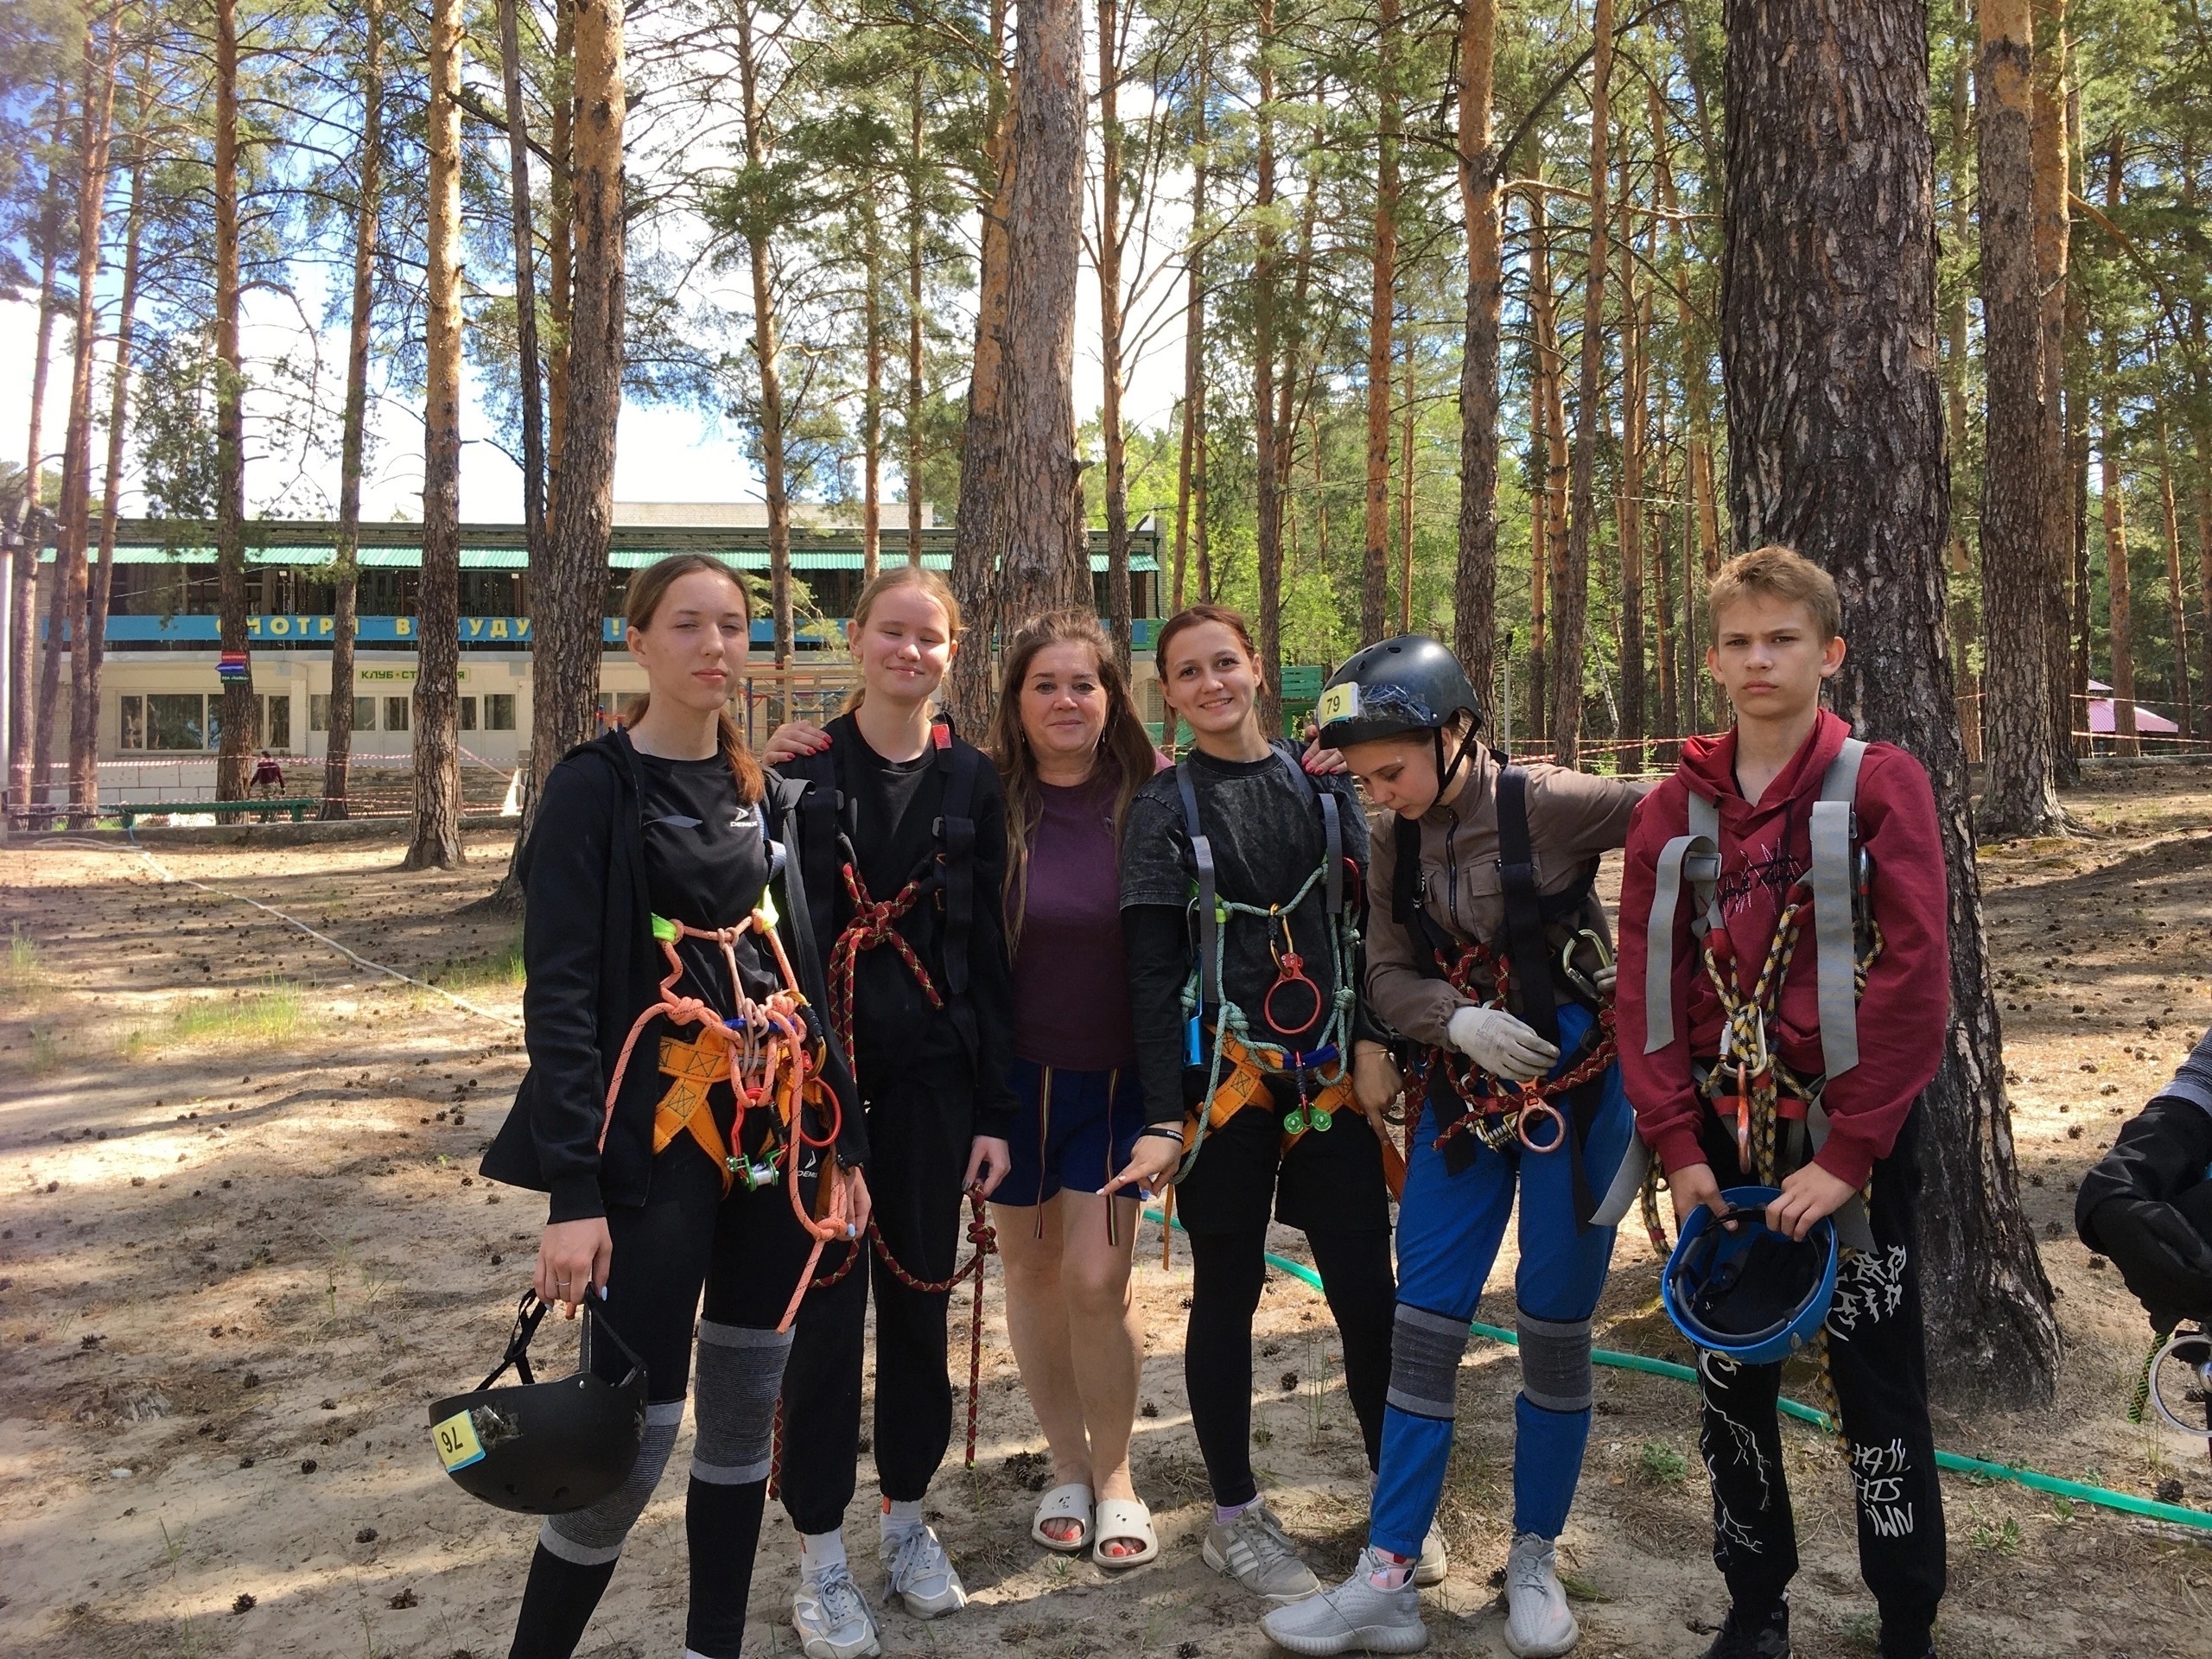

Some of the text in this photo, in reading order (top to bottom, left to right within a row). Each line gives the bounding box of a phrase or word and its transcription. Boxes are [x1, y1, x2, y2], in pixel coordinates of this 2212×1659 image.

[397, 618, 410, 635] В
[361, 671, 394, 679] КЛУБ
[1326, 696, 1340, 715] 79
[441, 1427, 463, 1452] 76
